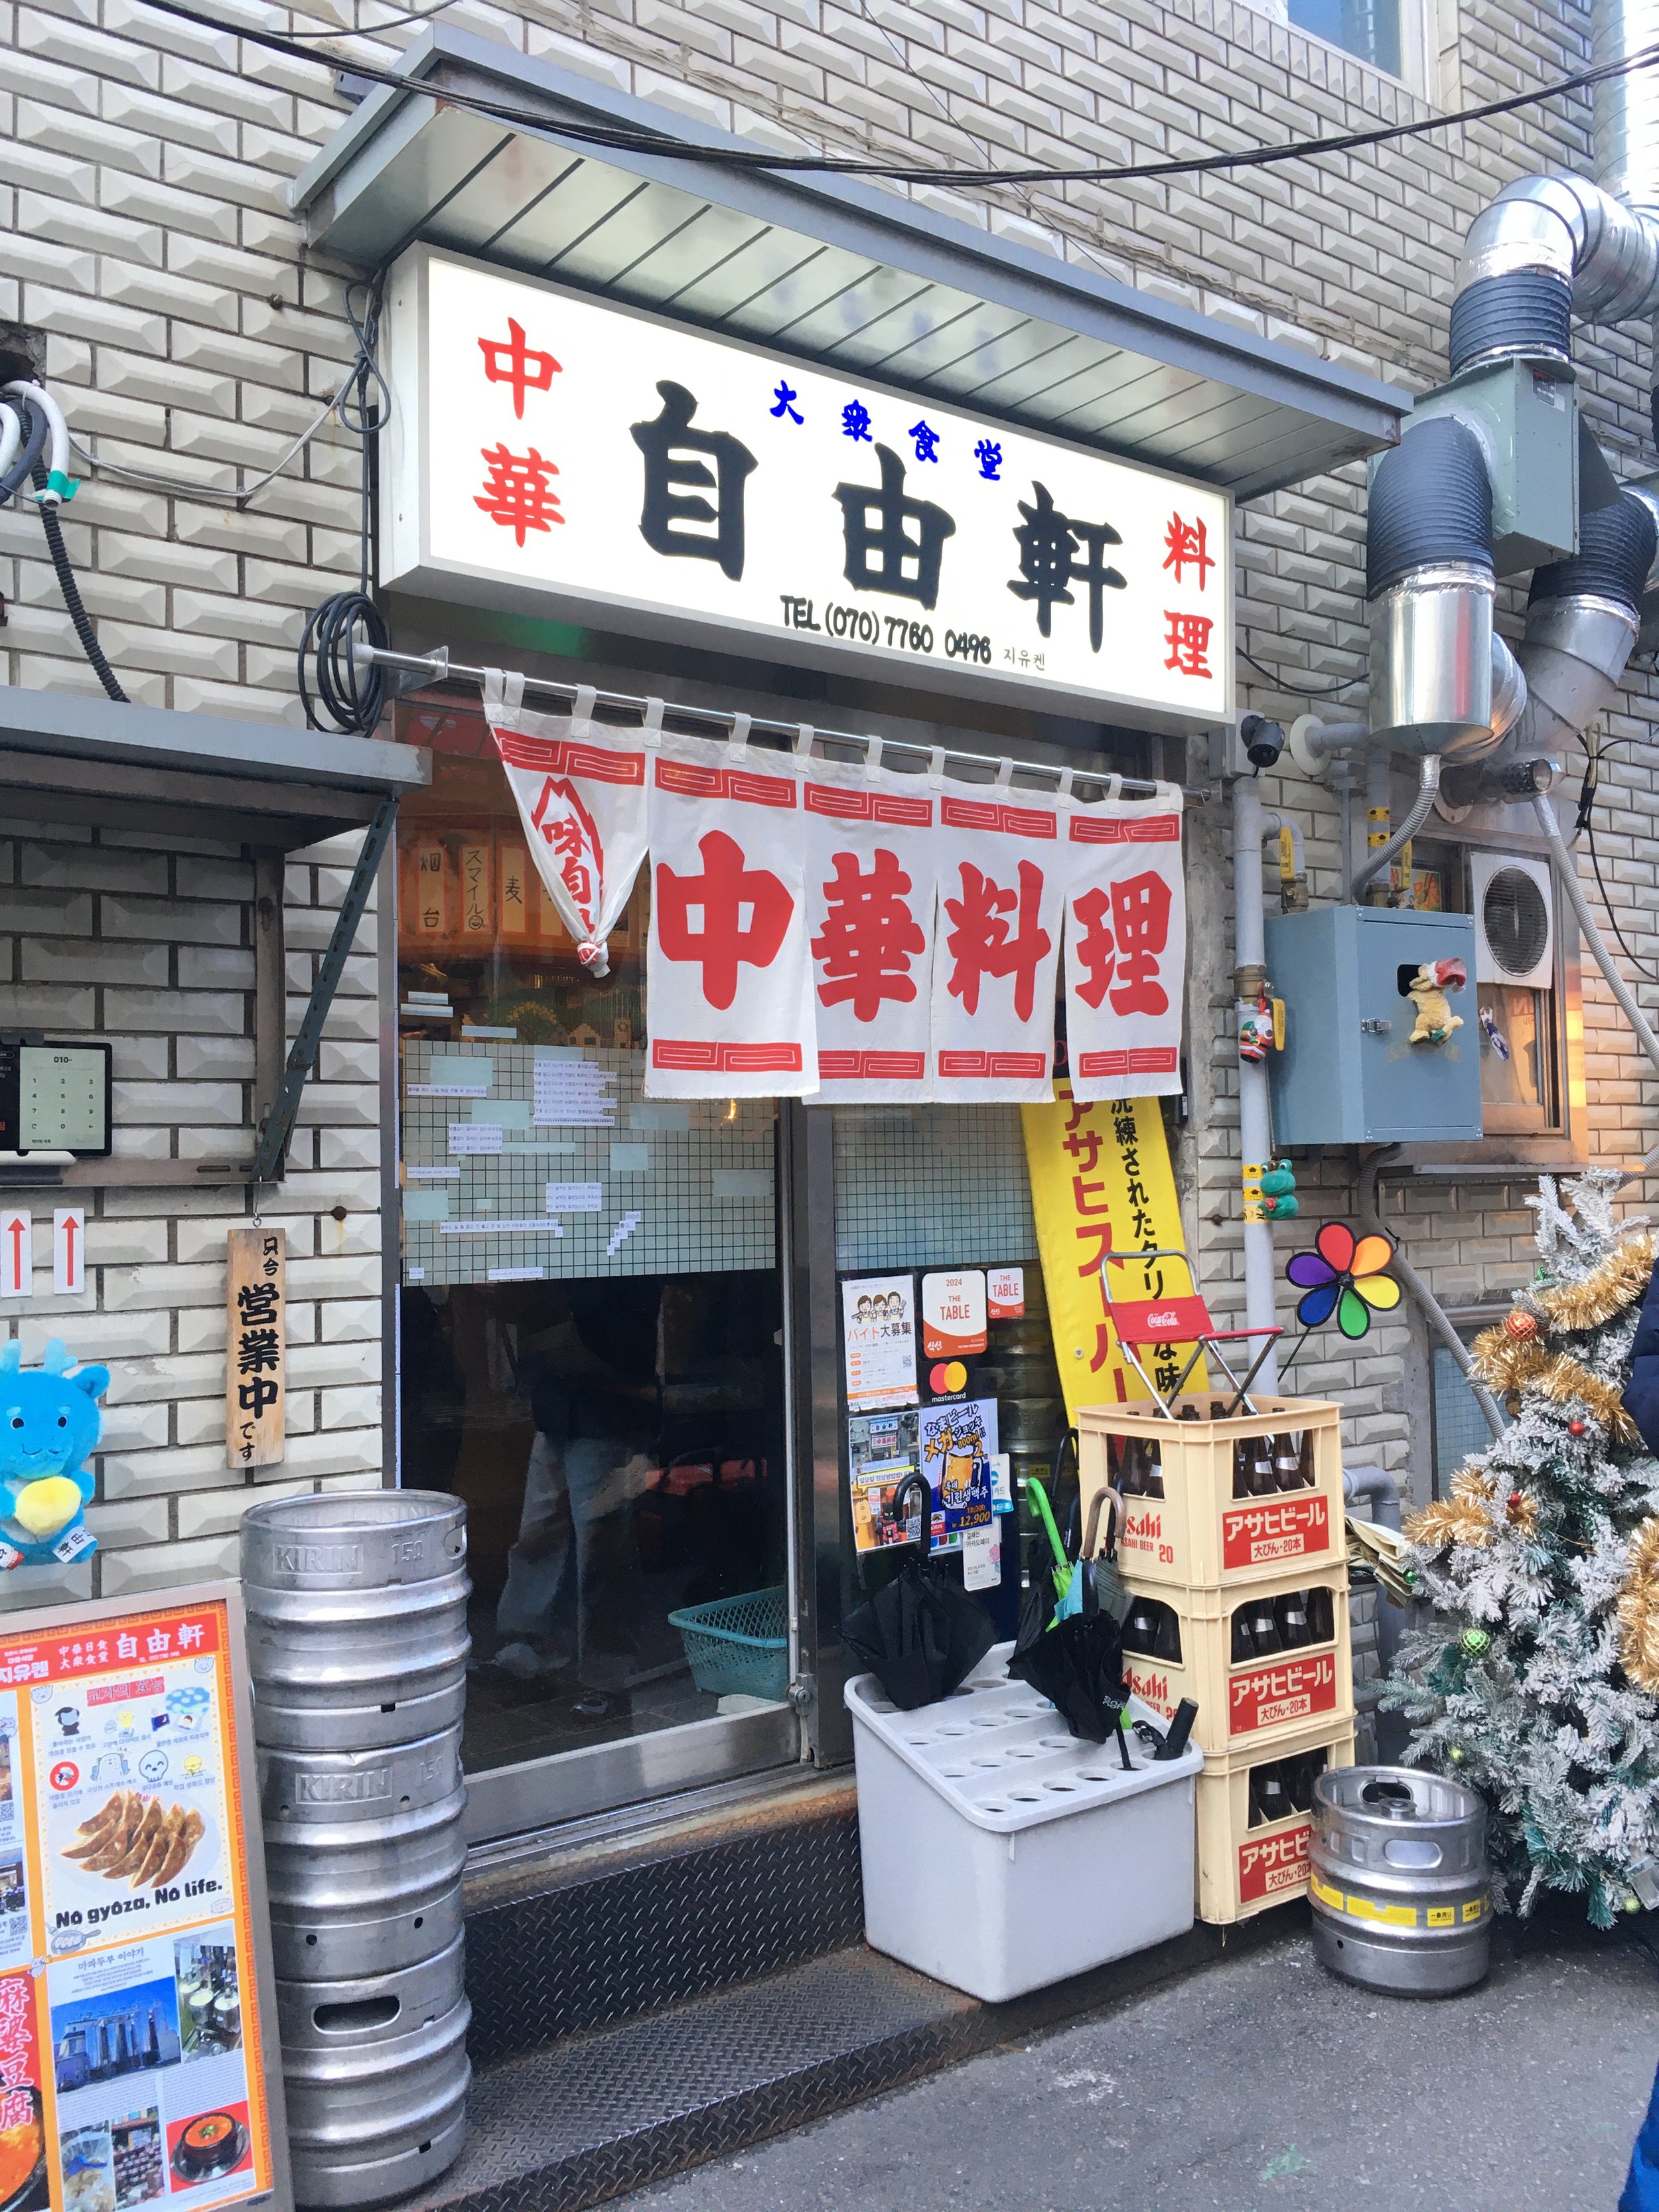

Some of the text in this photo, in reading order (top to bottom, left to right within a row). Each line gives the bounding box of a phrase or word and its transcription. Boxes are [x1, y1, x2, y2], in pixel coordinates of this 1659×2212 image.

[473, 317, 565, 548] 中華
[769, 380, 1003, 480] 大衆食堂
[629, 380, 1127, 653] 自由軒
[1163, 511, 1216, 679] 料理
[944, 629, 991, 665] 0496
[1003, 646, 1045, 672] 지유켄
[465, 849, 484, 915] スマイル
[505, 875, 523, 904] 麦
[656, 830, 1173, 1023] 中華料理
[946, 1278, 962, 1287] 2024
[992, 1283, 1019, 1297] TABLE
[940, 1304, 970, 1321] TABLE
[847, 1321, 912, 1342] バイト大募集
[932, 1392, 966, 1403] mastercard
[924, 1404, 979, 1437] なまビール
[957, 1432, 979, 1449] 800ml
[859, 1475, 875, 1484] 일요일
[945, 1485, 989, 1506] 기린생맥주
[959, 1511, 990, 1528] 12,900
[1126, 1512, 1162, 1540] sahi
[1226, 1502, 1326, 1542] アサヒビール
[966, 1530, 980, 1540] 결제는
[966, 1537, 989, 1548] 카카오페이
[1139, 1540, 1154, 1552] BEER
[275, 1545, 359, 1572] KIRIN
[1159, 1544, 1173, 1564] 20
[116, 1623, 205, 1659] 自由軒
[88, 1677, 165, 1704] 교자의 효능
[1121, 1666, 1168, 1702] Asahi
[1232, 1661, 1333, 1707] アサヒビール
[300, 1769, 388, 1801] KIRIN
[1242, 1830, 1310, 1875] アサヒビ
[184, 1878, 223, 1898] life.
[78, 1946, 144, 1971] 마파두부 이야기
